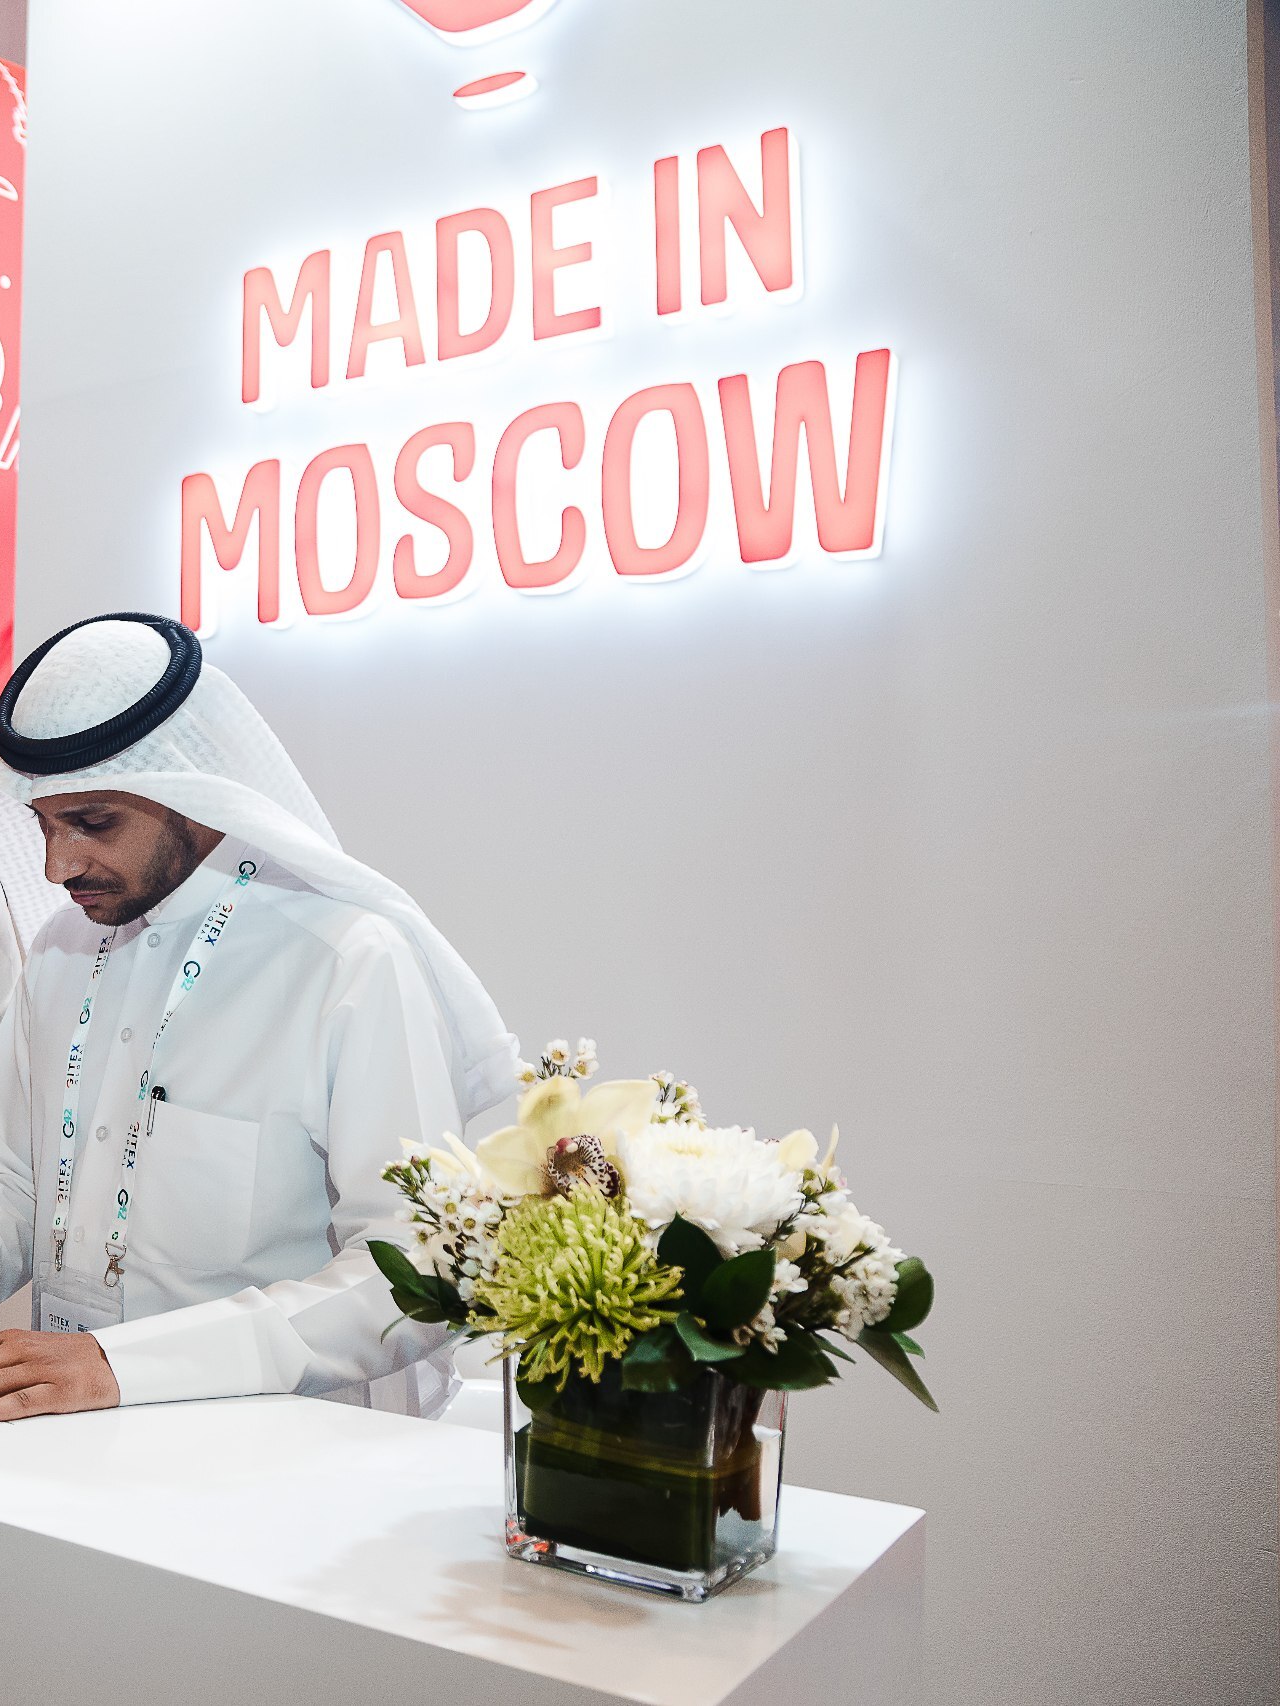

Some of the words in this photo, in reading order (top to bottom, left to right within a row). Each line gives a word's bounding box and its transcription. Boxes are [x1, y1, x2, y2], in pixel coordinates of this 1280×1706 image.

[242, 175, 602, 404] MADE
[654, 126, 793, 316] IN
[180, 347, 890, 632] MOSCOW
[235, 860, 257, 887] G42
[205, 903, 233, 947] GITEX
[181, 960, 201, 991] G42
[79, 996, 92, 1025] G42
[66, 1043, 81, 1089] GITEX
[62, 1108, 75, 1139] G42
[126, 1121, 140, 1170] GITEX
[57, 1158, 68, 1204] GITEX
[117, 1188, 129, 1220] G42
[48, 1313, 70, 1327] GITEX
